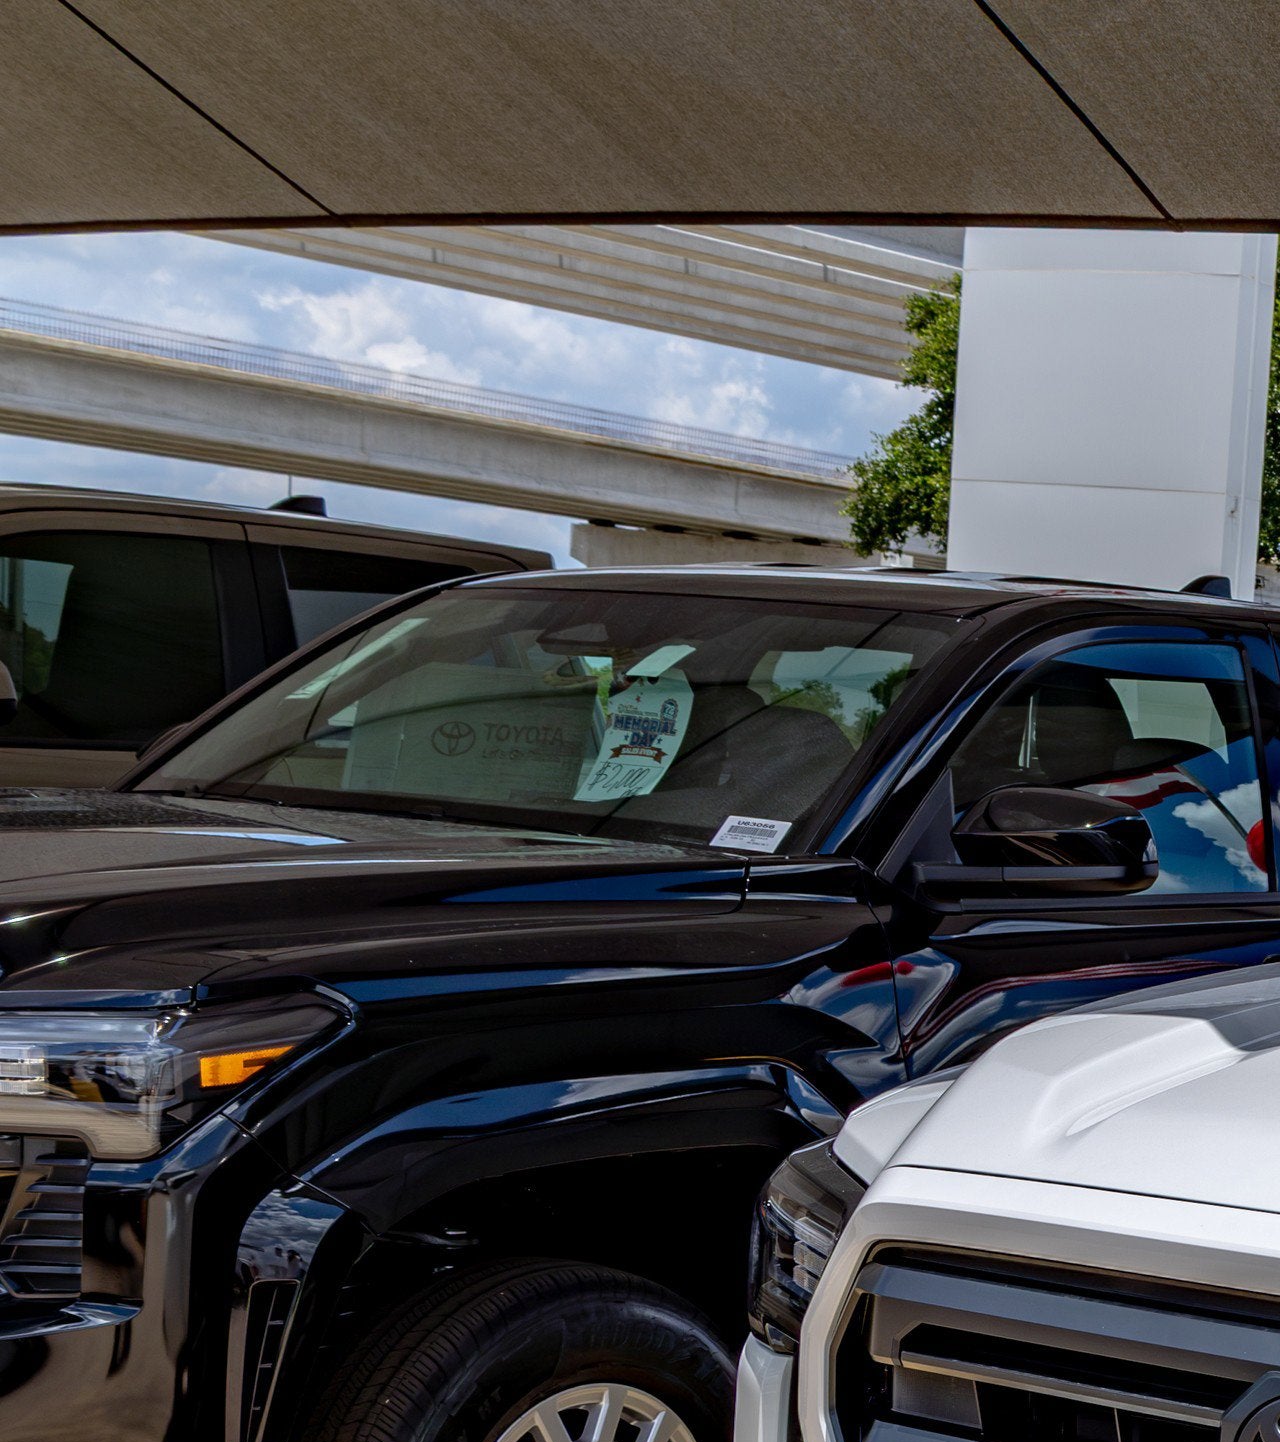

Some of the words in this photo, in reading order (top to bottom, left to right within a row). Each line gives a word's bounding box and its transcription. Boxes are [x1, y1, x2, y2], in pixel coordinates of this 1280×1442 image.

[482, 722, 565, 746] TOYOTA
[612, 713, 678, 736] MEMORIAL
[628, 731, 658, 747] DAY
